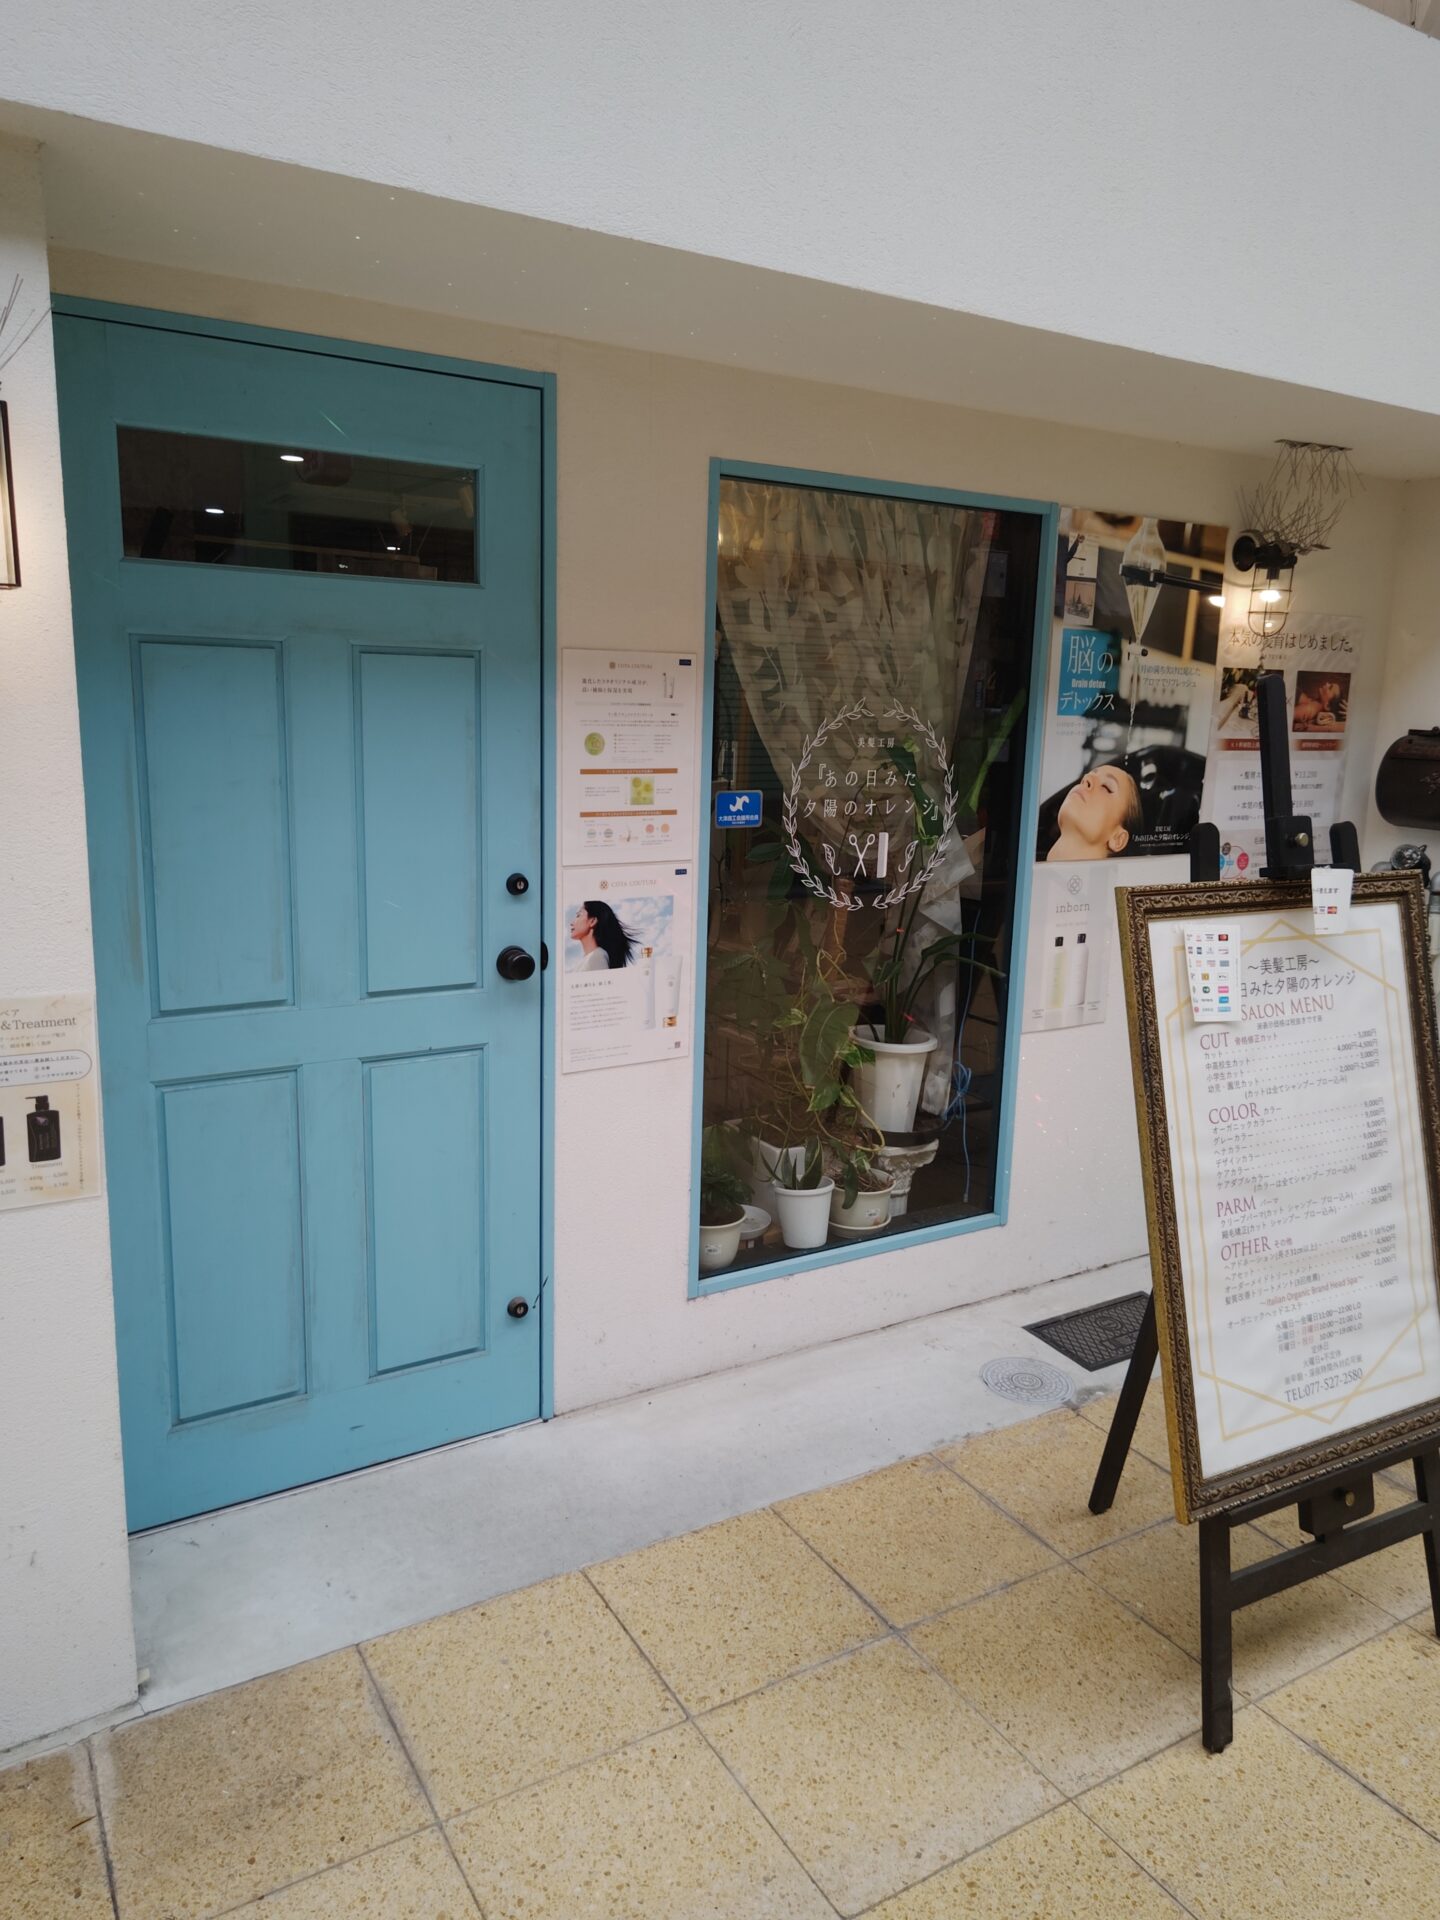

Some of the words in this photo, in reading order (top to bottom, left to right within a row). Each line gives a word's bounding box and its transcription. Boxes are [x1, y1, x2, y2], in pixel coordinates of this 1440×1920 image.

[1067, 635, 1114, 675] 脳の
[1088, 679, 1106, 689] detox
[1060, 692, 1115, 712] デトックス
[857, 737, 895, 748] 美髪工房
[818, 763, 917, 788] 『あの日みた
[802, 799, 939, 821] 夕陽のオレンジ』
[1056, 903, 1090, 913] inborn
[1241, 1001, 1286, 1021] SALON
[1291, 994, 1335, 1015] MENU
[1200, 1032, 1230, 1050] CUT
[1208, 1102, 1261, 1125] COLOR
[1216, 1195, 1257, 1217] PARM
[1221, 1236, 1271, 1262] OTHER
[1274, 1237, 1293, 1248] その他
[1311, 1342, 1329, 1353] 定休日
